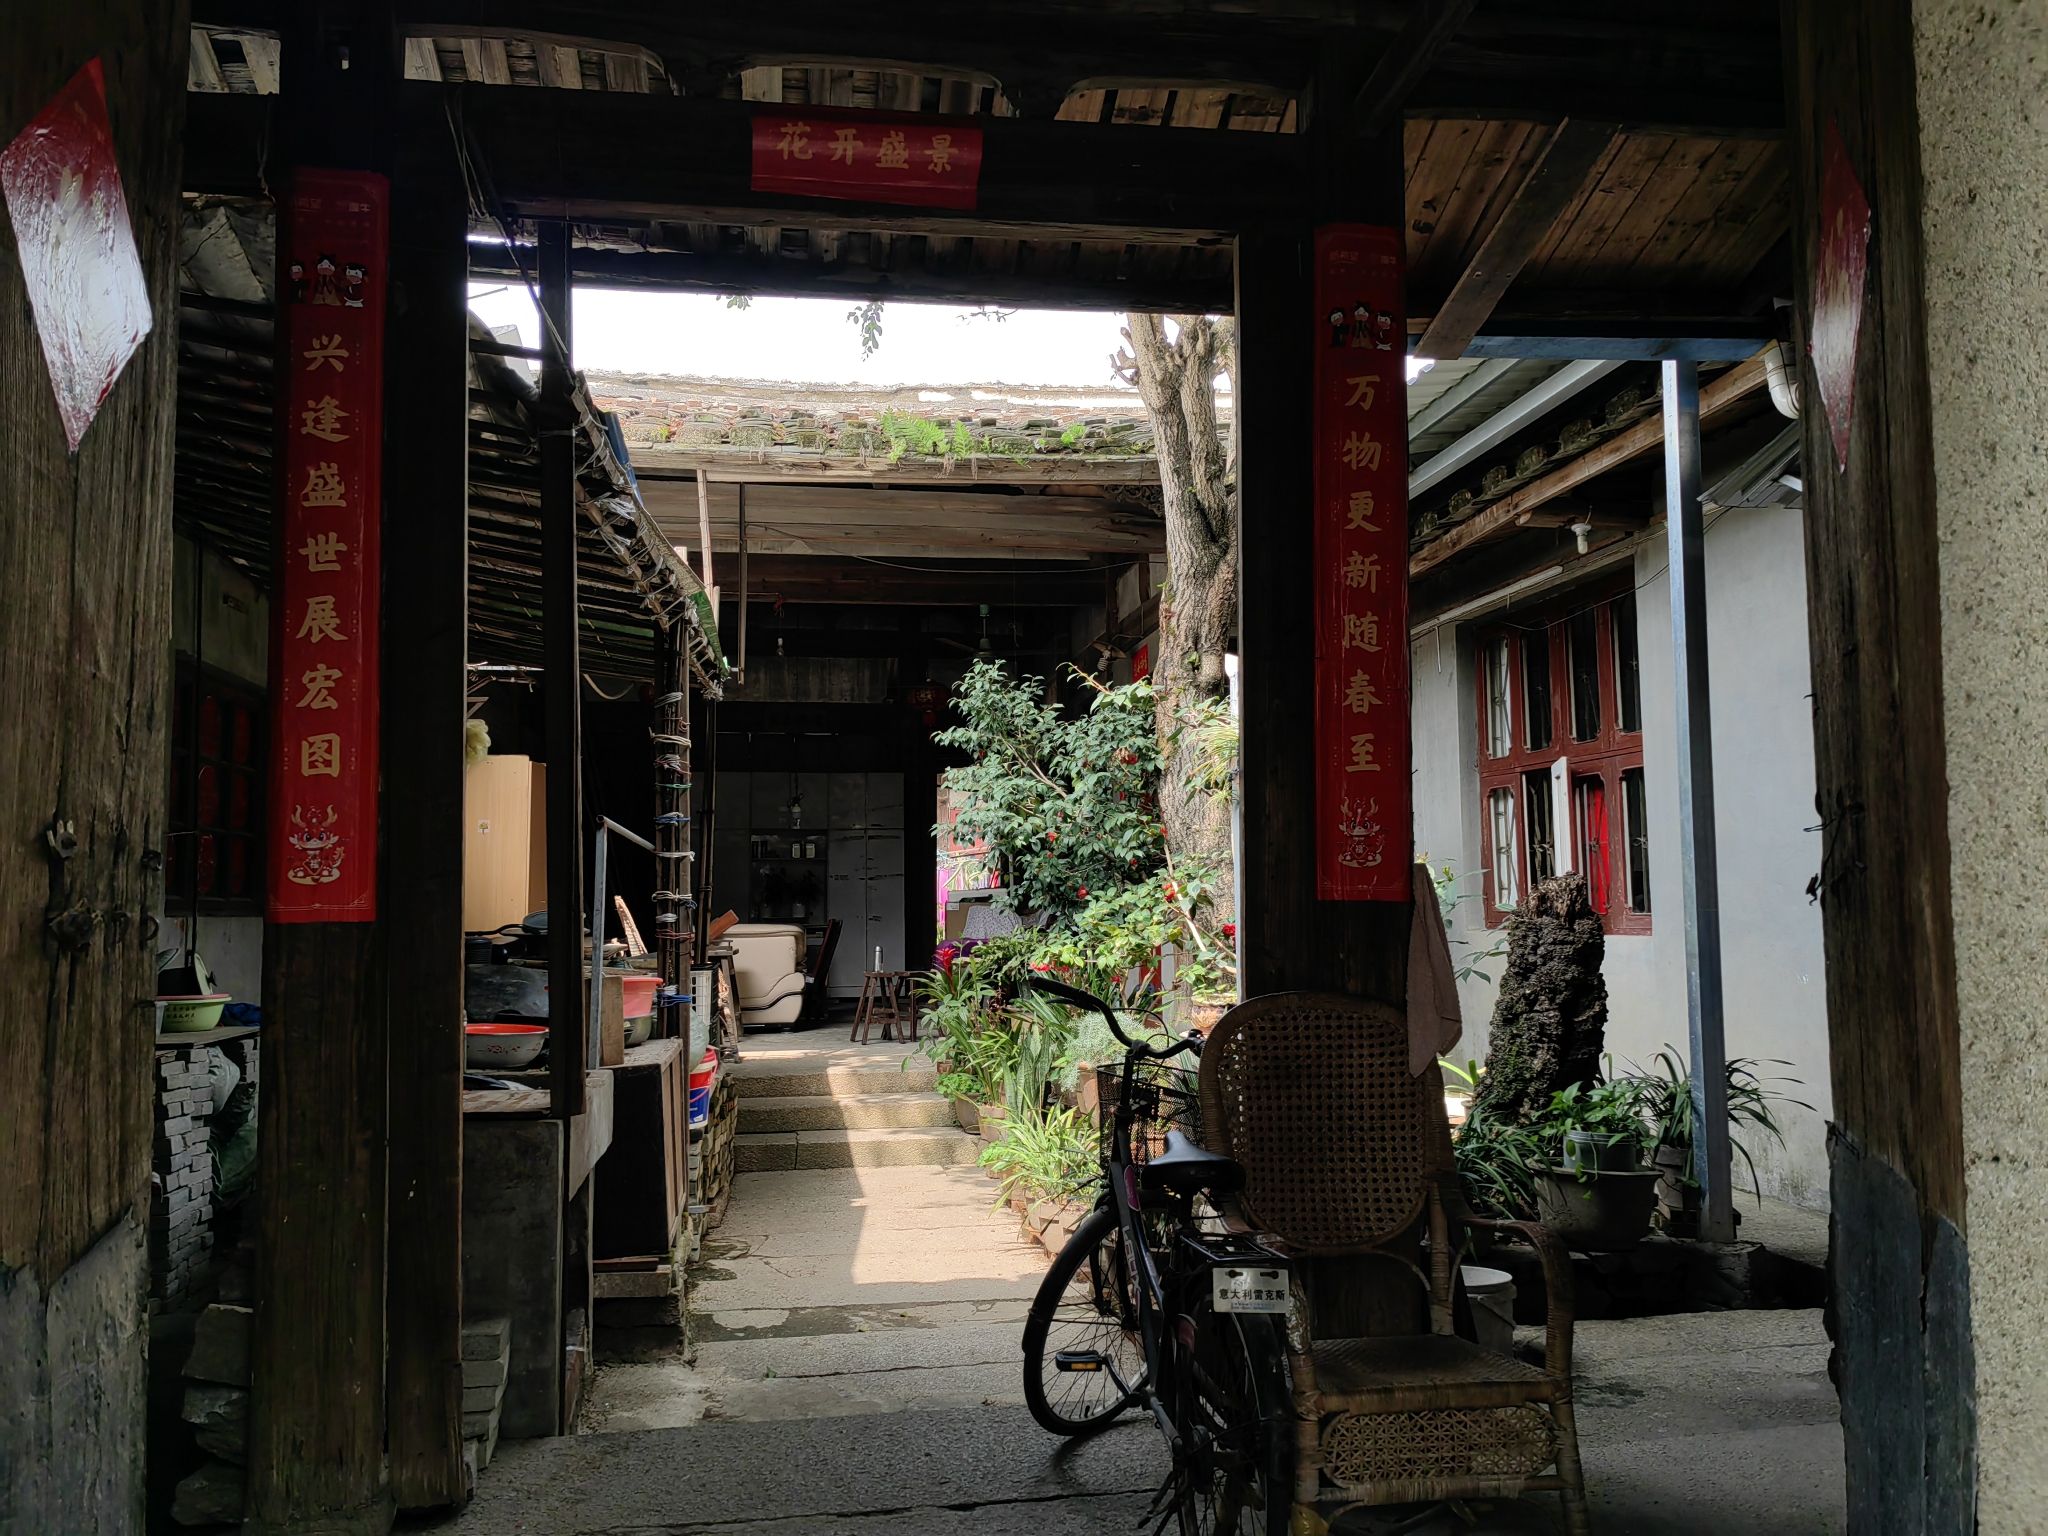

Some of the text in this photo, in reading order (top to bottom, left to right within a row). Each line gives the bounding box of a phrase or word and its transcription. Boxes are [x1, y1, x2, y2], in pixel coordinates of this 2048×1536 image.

[775, 120, 960, 174] 花开盛景
[295, 333, 350, 779] 兴逢盛世展宏图
[1341, 374, 1383, 774] 万物更新随春至
[1218, 1288, 1286, 1301] 意大利雷克斯
